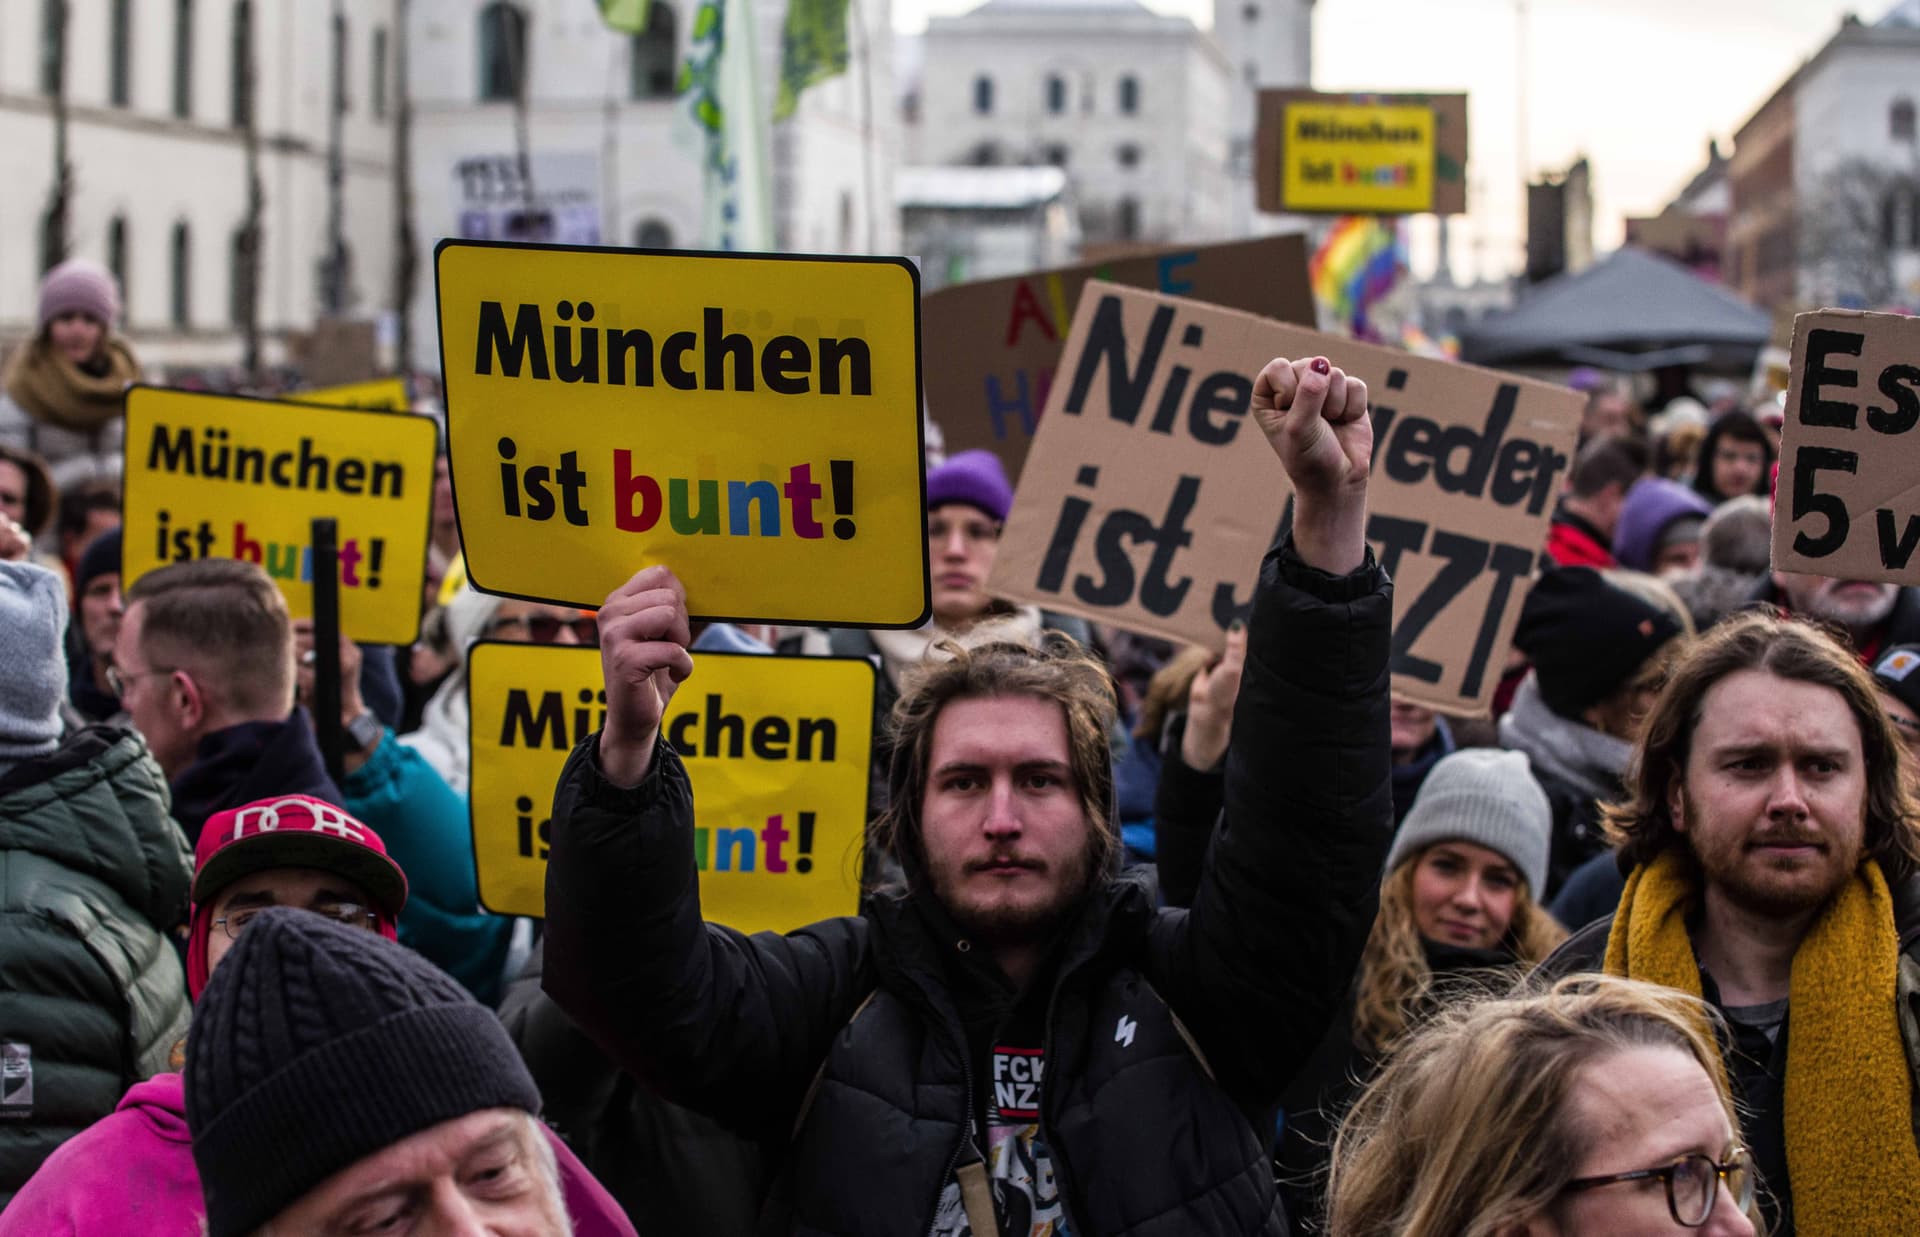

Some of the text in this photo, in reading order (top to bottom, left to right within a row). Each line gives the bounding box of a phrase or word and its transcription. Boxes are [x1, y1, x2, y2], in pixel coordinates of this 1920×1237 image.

[475, 301, 871, 395] München
[1799, 329, 1920, 434] Es
[1064, 295, 1566, 517] Nie ieder
[147, 423, 404, 499] München
[498, 437, 856, 540] ist bunt!
[1792, 446, 1858, 558] 5
[157, 510, 215, 562] ist
[1036, 465, 1535, 699] ist JTZT
[500, 688, 837, 762] Müchen
[234, 798, 365, 840] DOPE
[695, 811, 816, 874] nt!
[995, 1082, 1041, 1110] NZ
